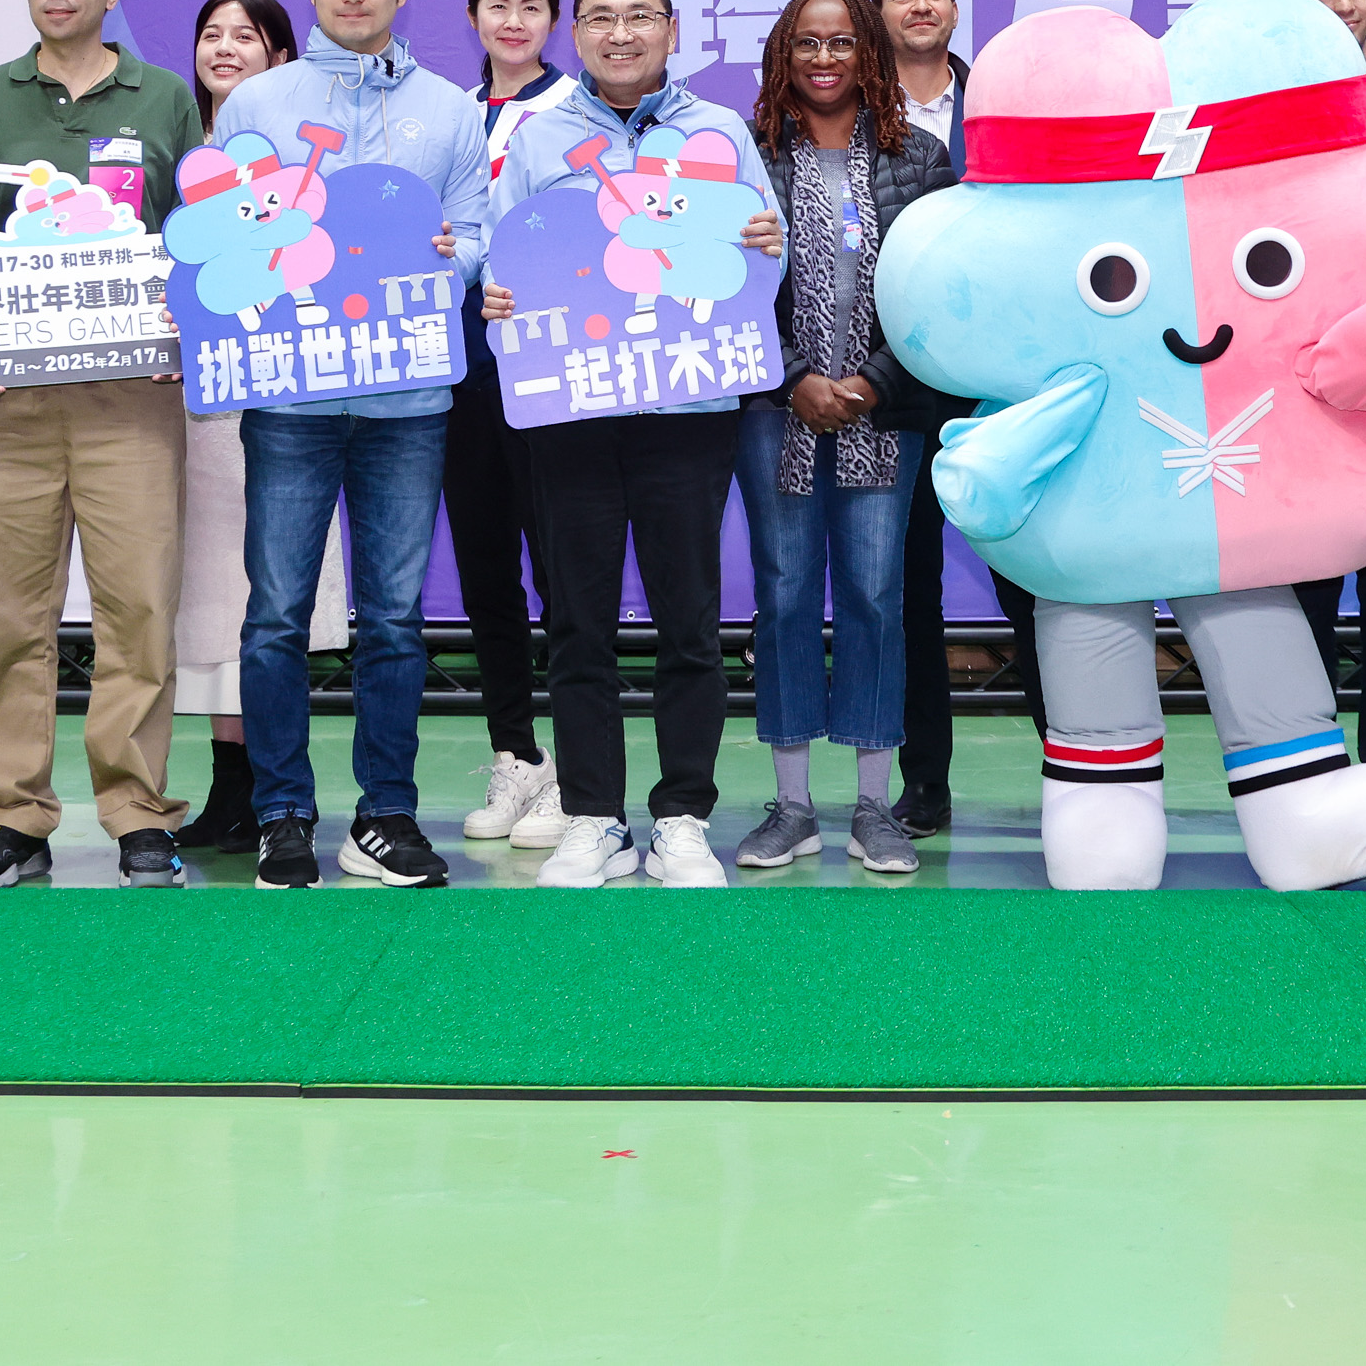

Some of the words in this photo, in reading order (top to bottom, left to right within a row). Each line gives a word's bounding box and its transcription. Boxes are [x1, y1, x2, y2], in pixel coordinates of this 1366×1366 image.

[121, 169, 135, 190] 2
[61, 245, 170, 269] 和世界挑一場
[69, 311, 173, 341] GAMES
[196, 316, 452, 404] 挑戰世壯運
[513, 322, 768, 412] 一起打木球
